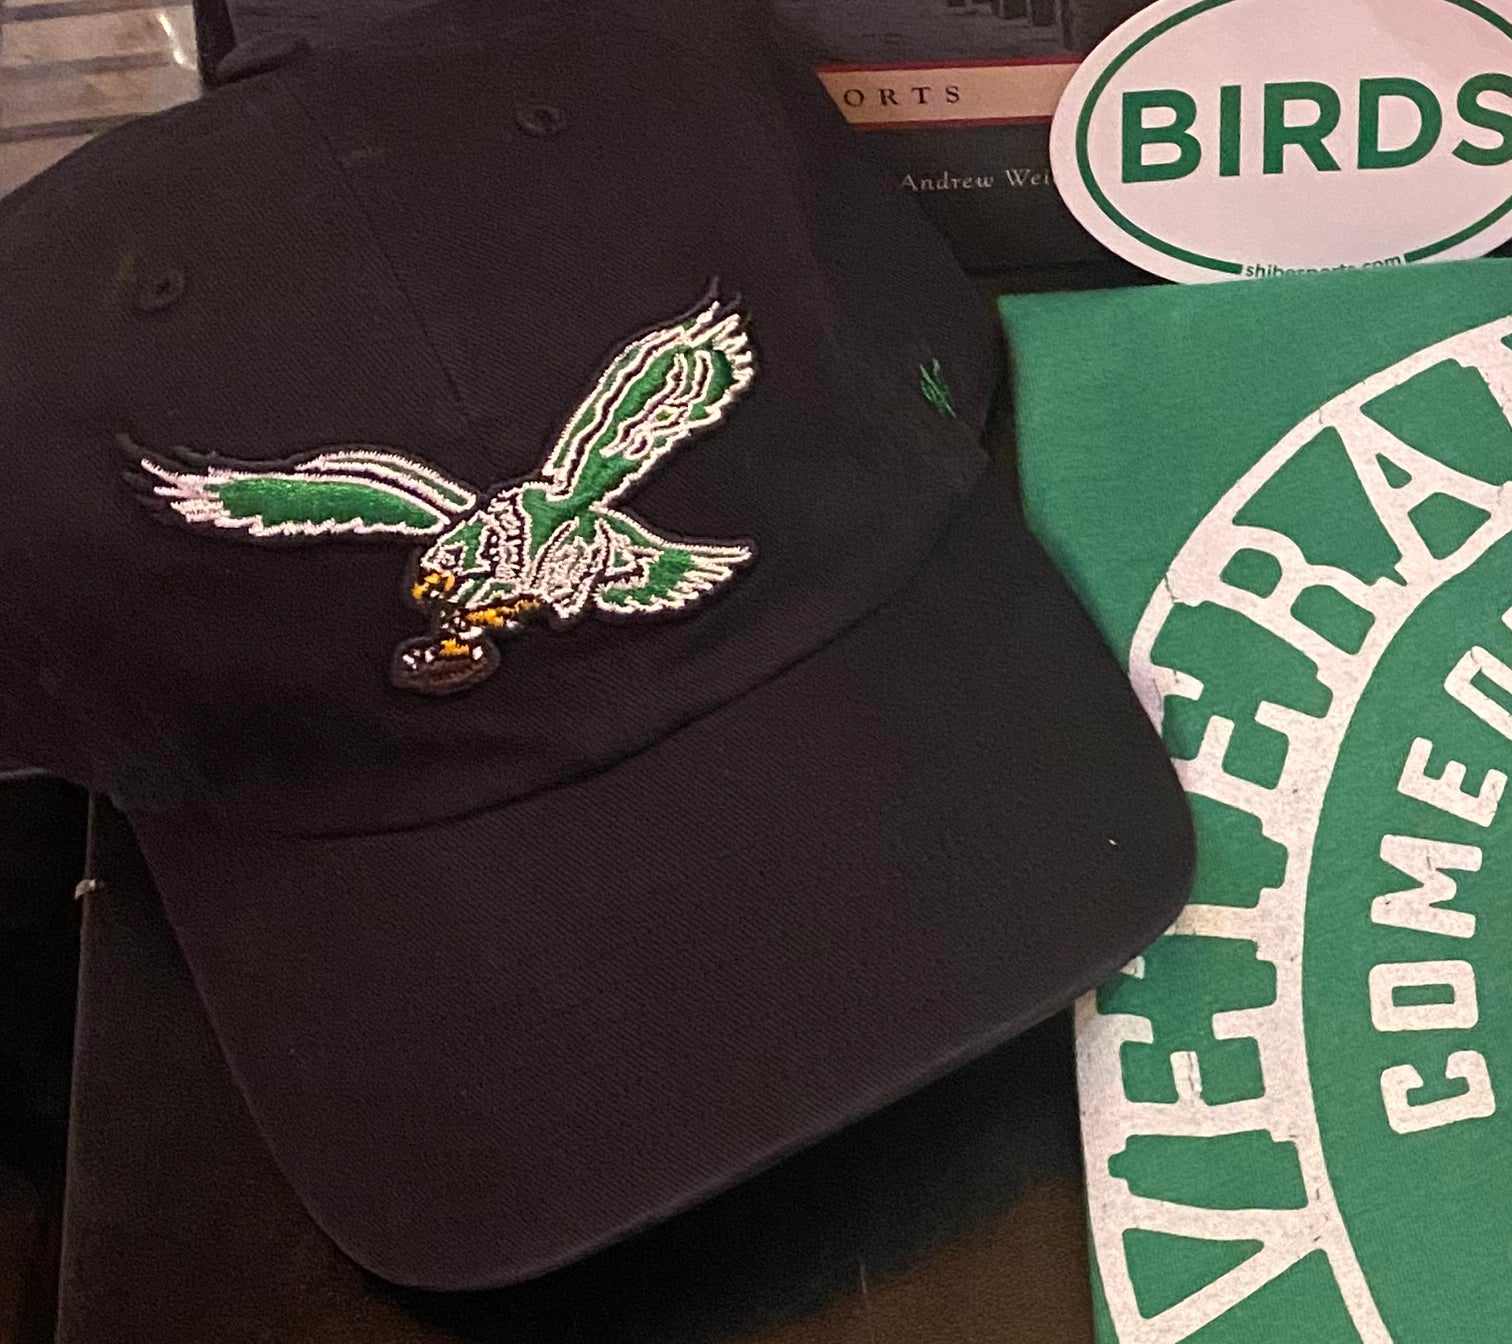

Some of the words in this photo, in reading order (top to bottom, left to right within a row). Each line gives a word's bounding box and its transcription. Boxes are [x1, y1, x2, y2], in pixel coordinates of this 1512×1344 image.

[843, 86, 961, 107] ORTS
[901, 170, 995, 191] Andrew
[1005, 167, 1050, 187] Wei
[1368, 736, 1508, 1134] COME
